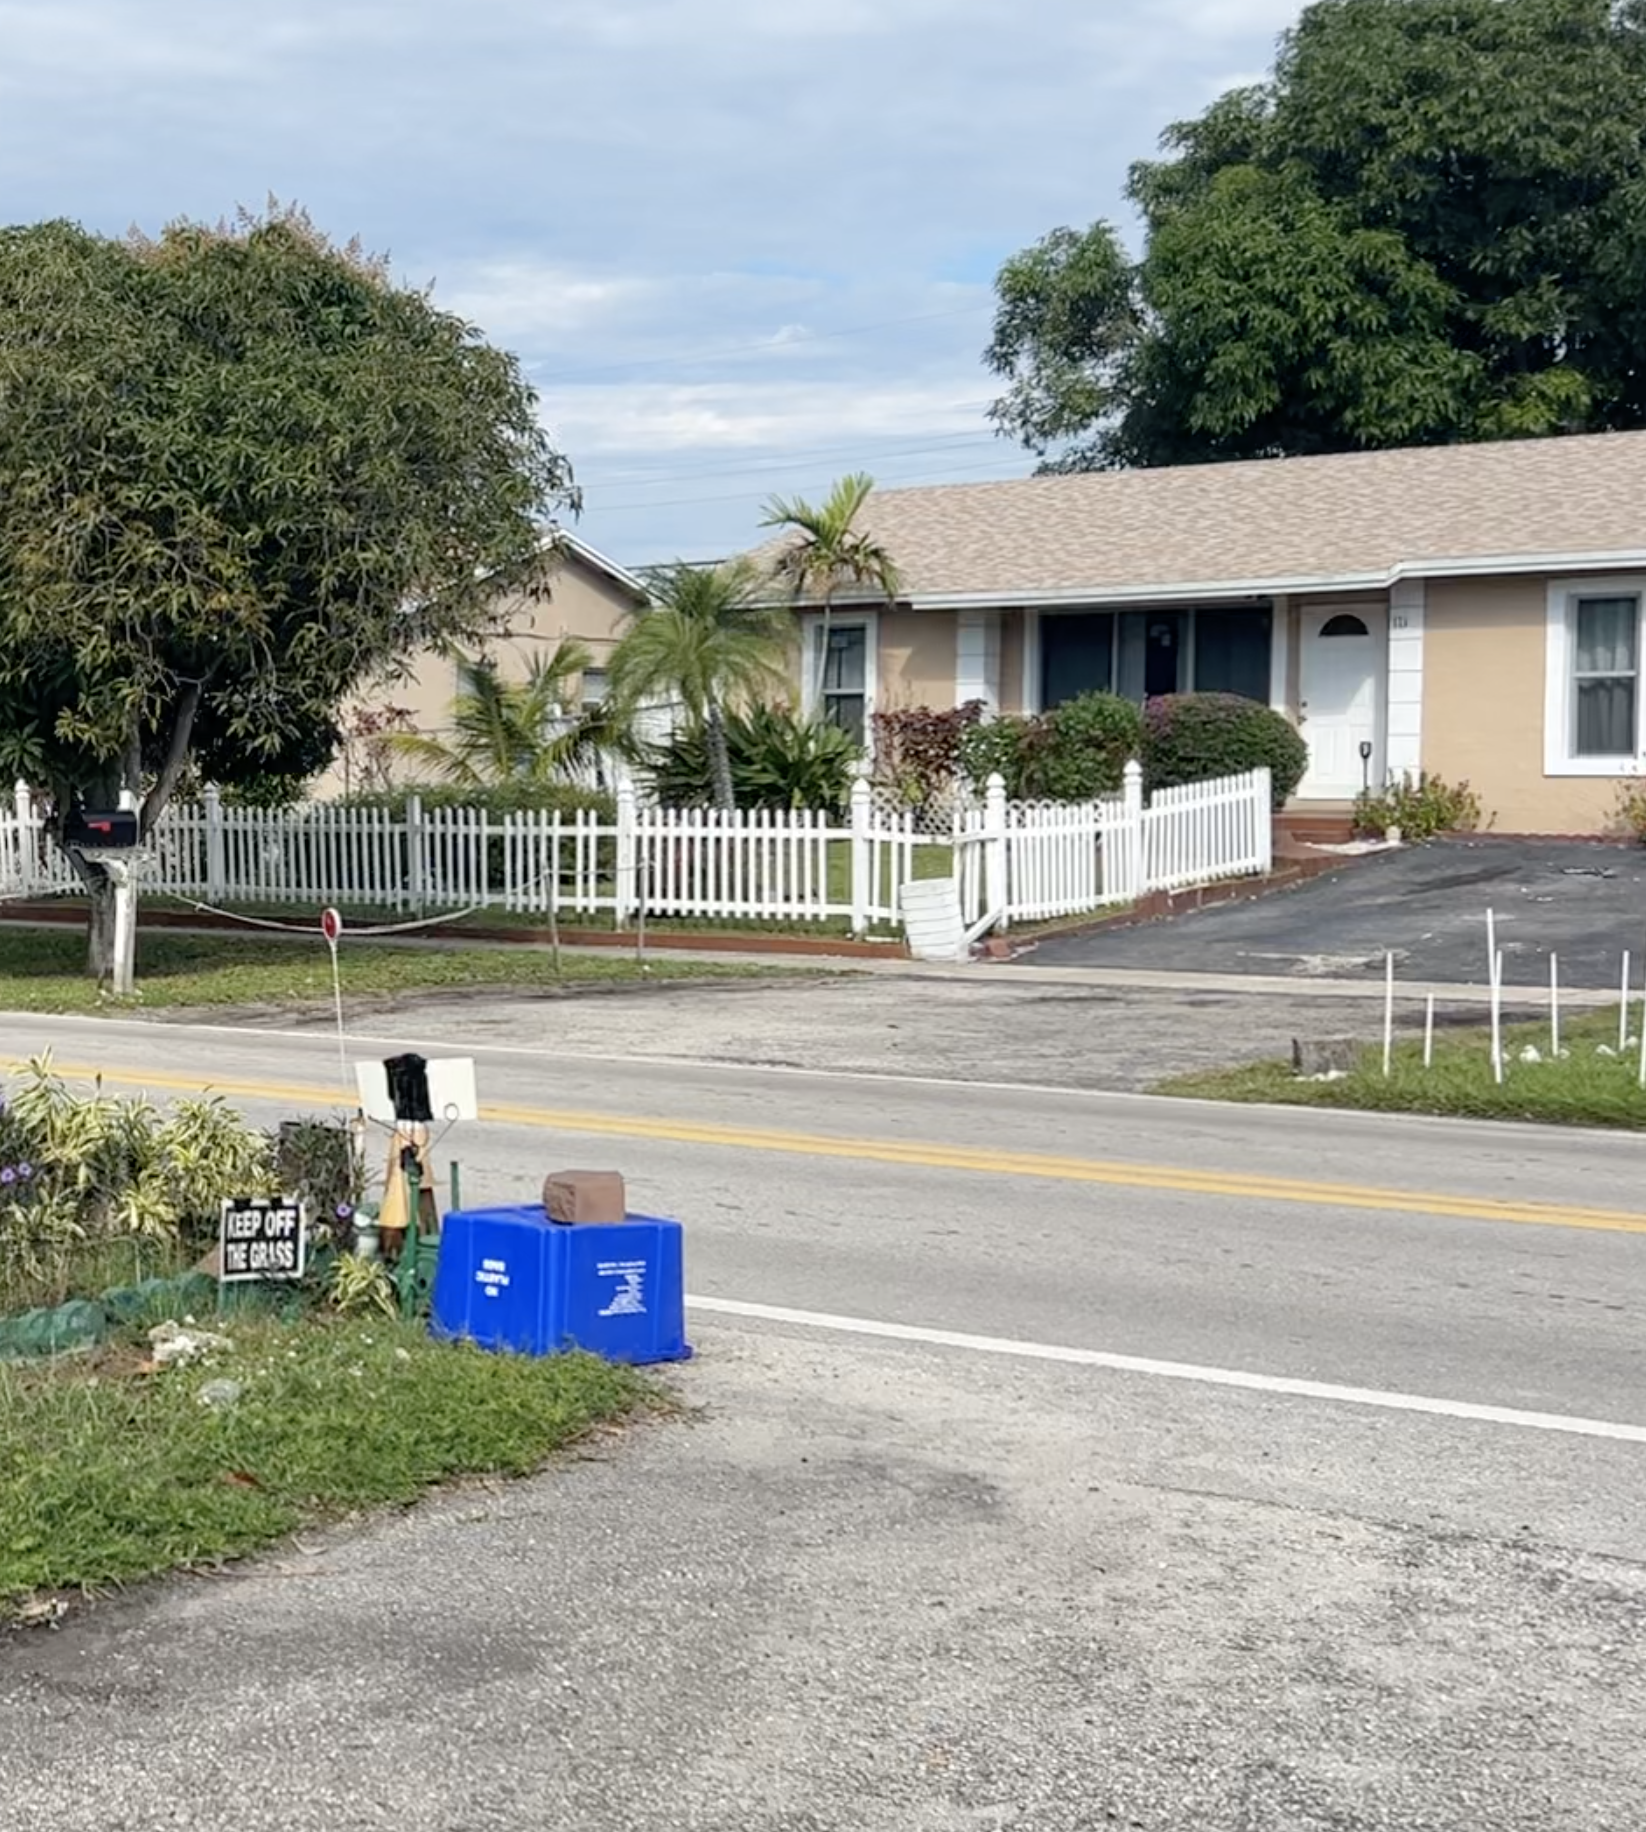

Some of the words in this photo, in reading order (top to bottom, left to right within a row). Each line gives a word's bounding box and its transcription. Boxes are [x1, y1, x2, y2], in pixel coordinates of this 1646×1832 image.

[227, 1210, 262, 1240] KEEP
[264, 1209, 297, 1238] OFF
[227, 1242, 248, 1271] THE
[250, 1240, 294, 1270] GRASS
